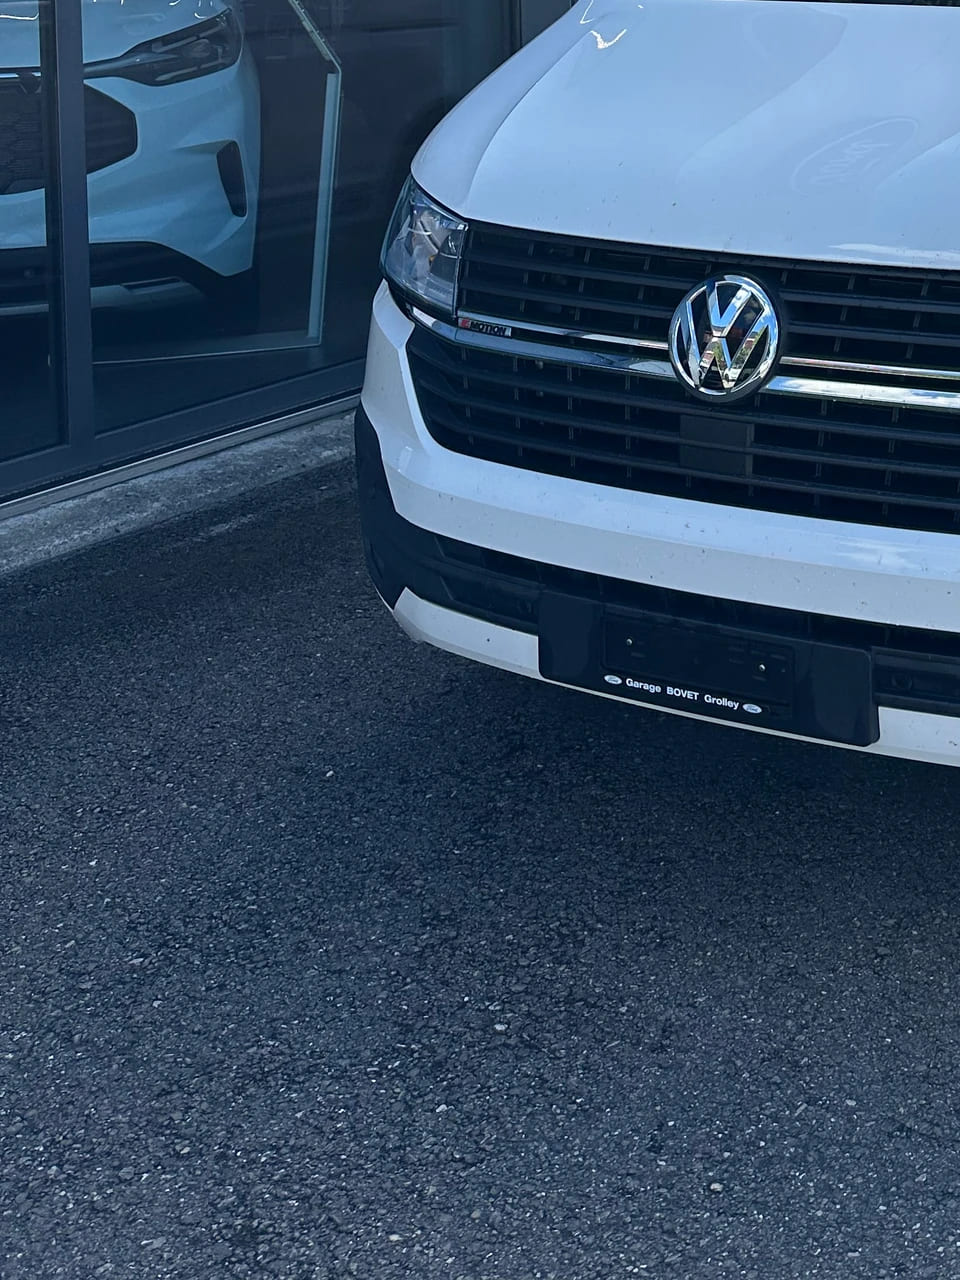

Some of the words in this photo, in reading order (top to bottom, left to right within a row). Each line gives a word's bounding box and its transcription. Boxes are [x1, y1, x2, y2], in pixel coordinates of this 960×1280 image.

[626, 678, 661, 693] Garage
[667, 686, 699, 700] BOVET
[704, 694, 739, 710] Grolley
